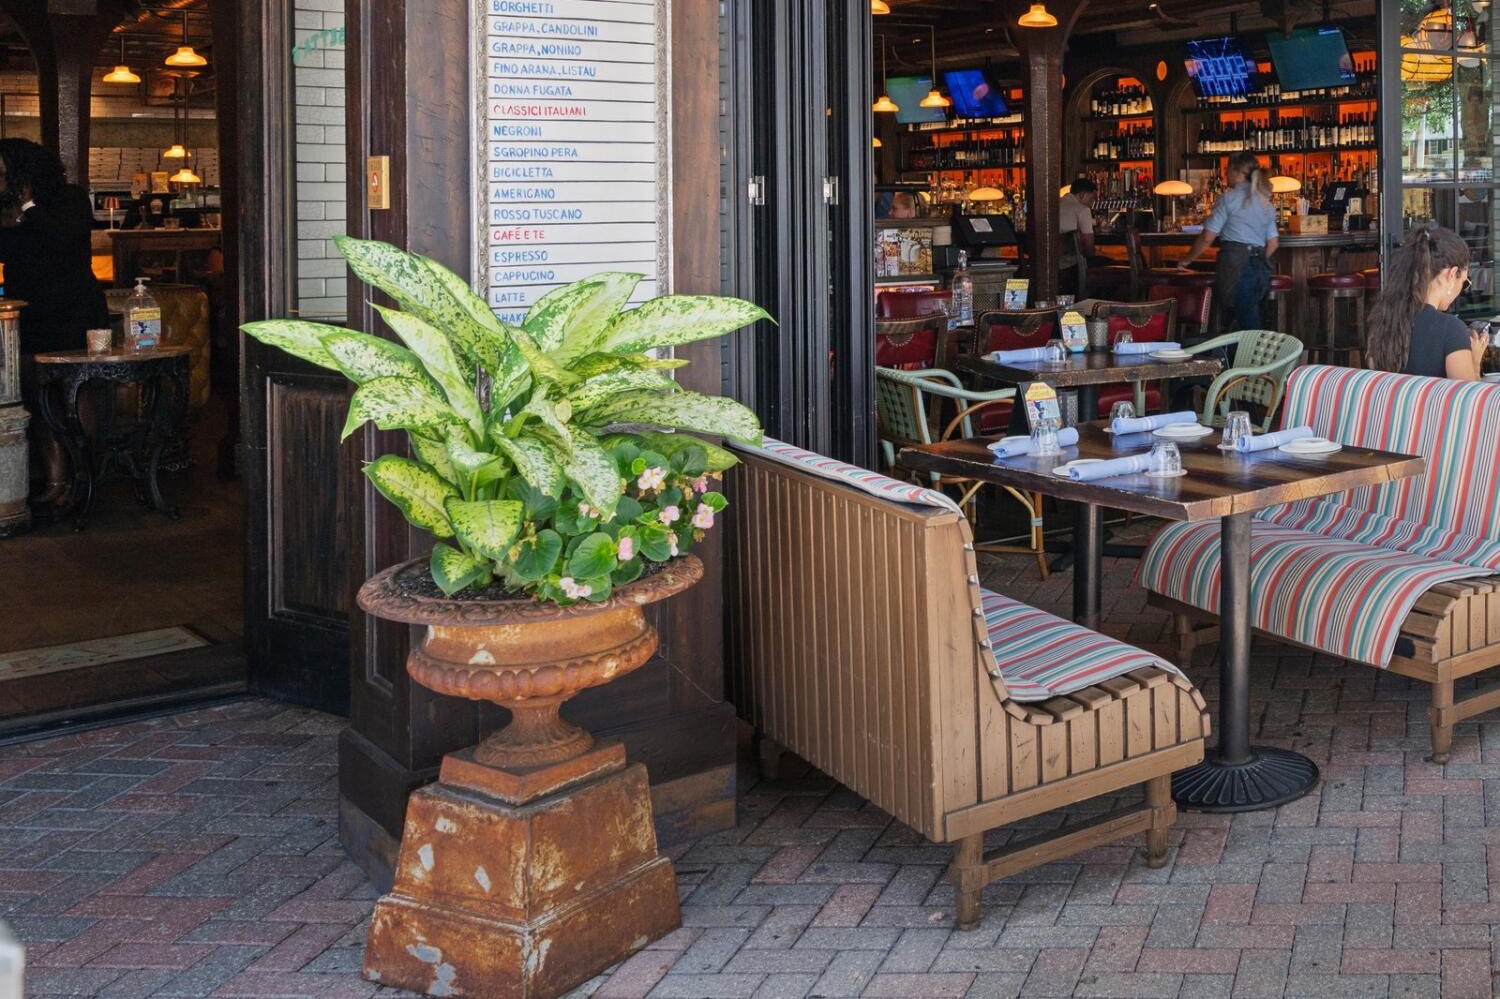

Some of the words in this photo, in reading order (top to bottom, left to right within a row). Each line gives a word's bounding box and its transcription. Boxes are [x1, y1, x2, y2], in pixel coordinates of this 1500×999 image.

[493, 0, 553, 14] BORGHETTI
[541, 23, 598, 36] CANDOLINI
[541, 44, 581, 56] NONINO
[494, 62, 519, 74] FINO
[494, 83, 530, 94] DONNA
[533, 85, 572, 96] FUGATA
[493, 104, 541, 116] CLASSICI
[544, 106, 586, 116] ITALIANI
[493, 125, 542, 136] NEGRONI
[494, 147, 549, 158] SGROPINO
[551, 147, 578, 158] PERA
[493, 167, 553, 178] BICICLETTA
[494, 209, 531, 220] ROSSO
[532, 208, 583, 220] TUSCANO
[493, 227, 521, 240] CAFÉ
[524, 230, 530, 240] E
[494, 250, 548, 263] ESPRESSO
[494, 270, 555, 282] CAPPUCINO
[495, 292, 525, 303] LATTE
